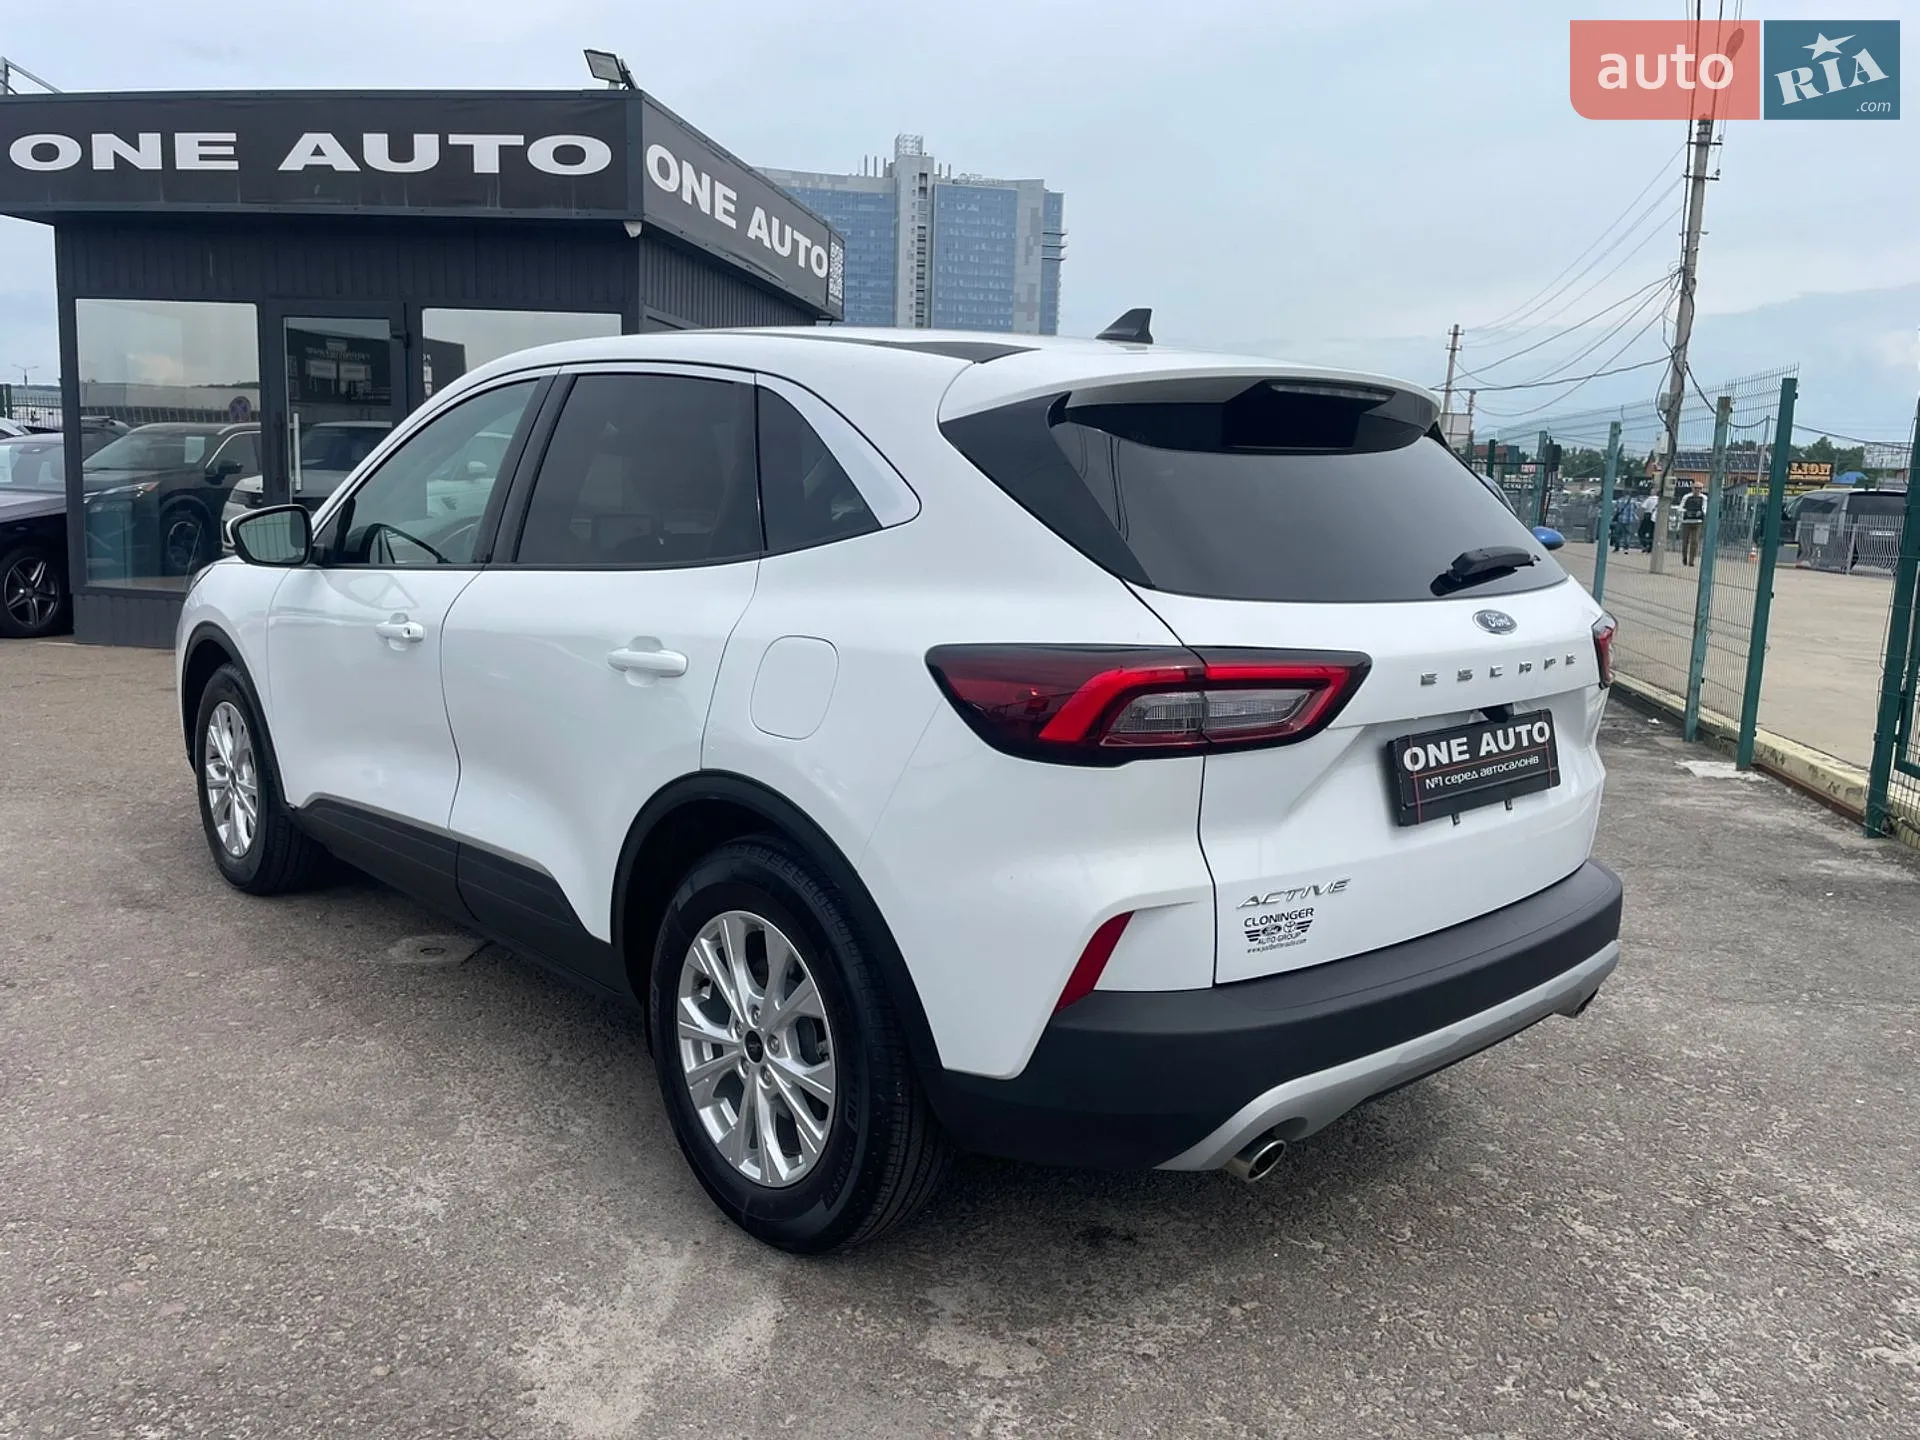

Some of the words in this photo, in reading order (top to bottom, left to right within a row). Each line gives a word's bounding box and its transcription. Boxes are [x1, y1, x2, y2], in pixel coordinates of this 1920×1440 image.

[9, 132, 239, 170] ONE
[278, 132, 612, 175] AUTO
[646, 144, 738, 230] ONE
[747, 206, 829, 279] AUTO
[1420, 653, 1577, 686] ESCAPE
[1403, 736, 1470, 772] ONE
[1479, 721, 1550, 757] AUTO
[1445, 769, 1479, 786] серед
[1480, 754, 1540, 777] автосалонів
[1236, 878, 1351, 910] ACTIVE
[1244, 907, 1314, 928] CLONINGER
